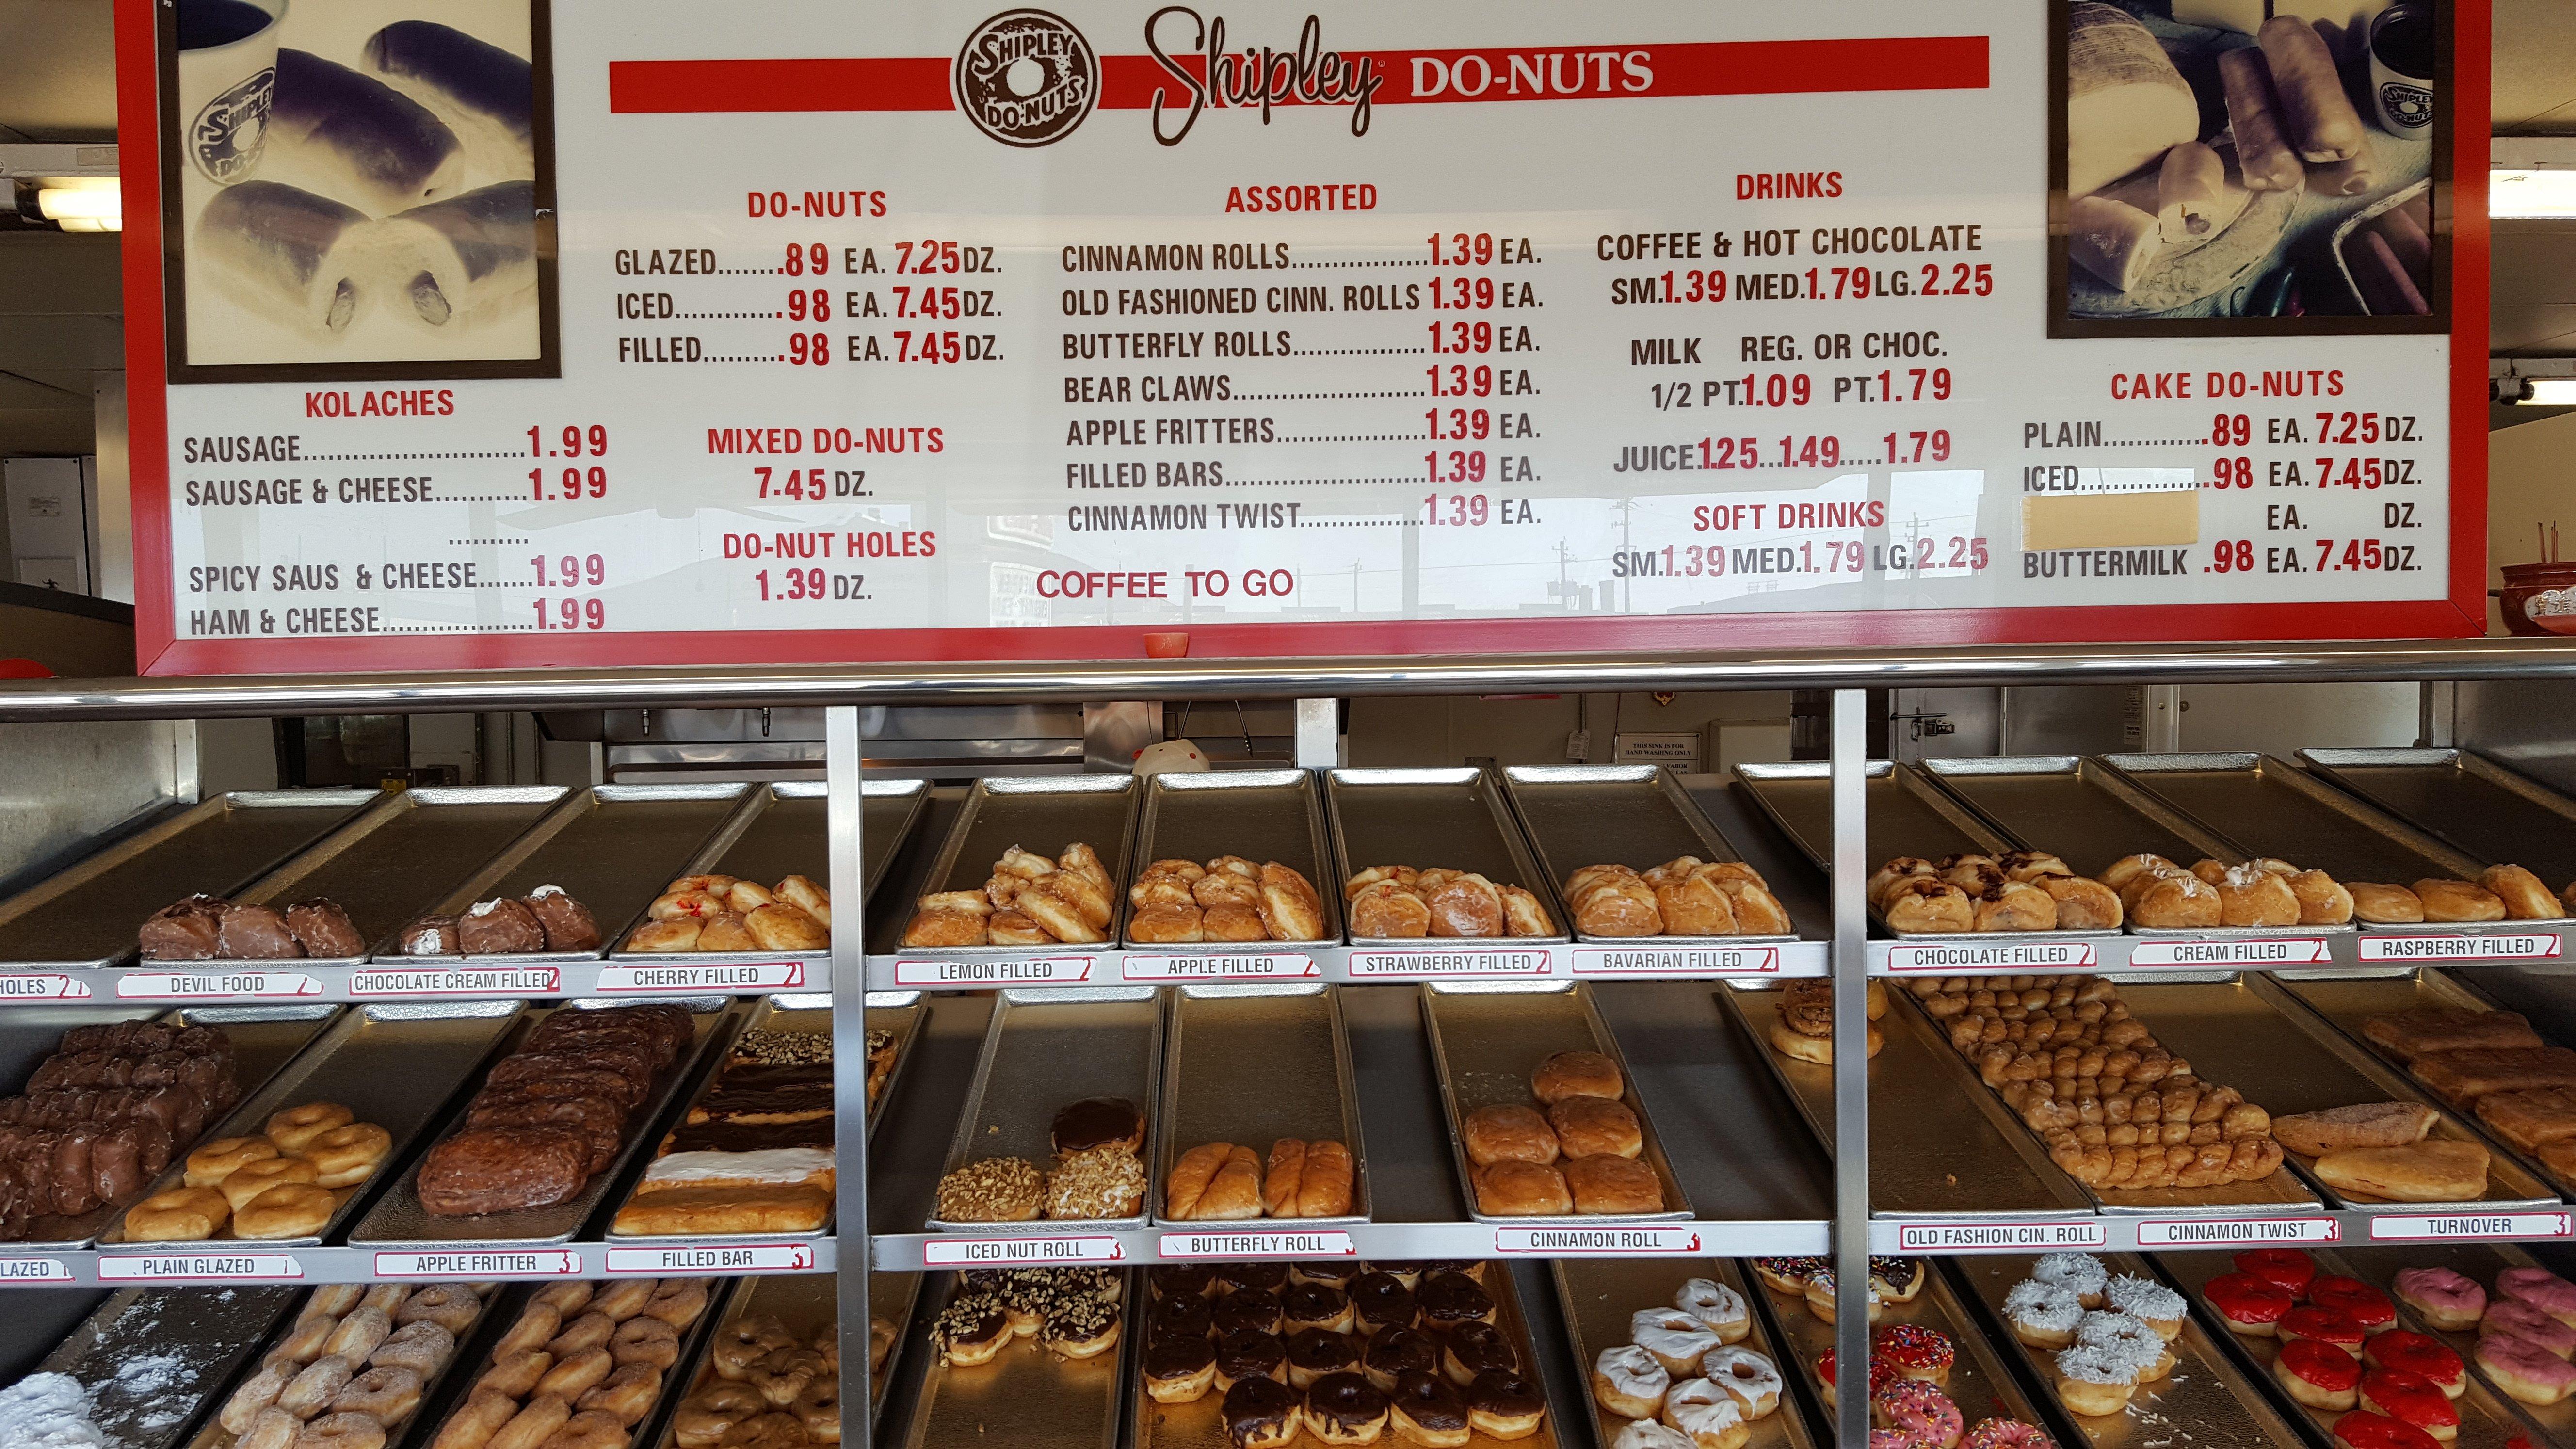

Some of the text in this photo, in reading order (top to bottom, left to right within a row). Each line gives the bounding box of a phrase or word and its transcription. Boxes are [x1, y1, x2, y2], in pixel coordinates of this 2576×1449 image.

[972, 33, 1073, 75] SHIPLEY
[1145, 6, 1655, 146] Shipley DO-NUTS
[987, 78, 1079, 128] DO-NUTS
[1225, 184, 1376, 212] ASSORTED
[1737, 172, 1842, 200] DRINKS
[748, 191, 886, 217] DO-NUTS
[616, 249, 715, 275] GLAZED
[895, 240, 959, 274] 7.25
[1063, 233, 1492, 272] CINNAMON ROLLS 1.39
[1598, 225, 1981, 260] COFFEE HOT CHOCOLATE
[1063, 277, 1494, 315] OLD FASHIONED CINN. ROLLS 1.39
[1659, 270, 1726, 303] 1.39
[1803, 267, 1870, 299] 1.79
[1921, 263, 1992, 296] 2.25
[618, 293, 673, 319] ICED
[893, 287, 960, 319] 7.45
[619, 337, 701, 362] FILLED
[894, 331, 960, 364] 7.45
[1063, 321, 1491, 359] BUTTERFLY ROLLS 1.39
[1632, 331, 1947, 365] MILK REG. OR CHOC.
[1065, 365, 1491, 402] BEAR CLAWS 1.39
[1652, 382, 1691, 411] 1/2
[1740, 374, 1810, 407] 1.09
[1878, 368, 1950, 401] 1.79
[2112, 370, 2343, 399] CAKE DO-NUTS
[306, 390, 453, 417] KOLACHES
[708, 428, 943, 453] MIXED DO-NUTS
[1067, 408, 1489, 445] APPLE FRITTERS 1.39
[2025, 421, 2101, 448] PLAIN
[2316, 412, 2379, 444] 7.25
[185, 425, 607, 463] SAUSAGE 1.99
[1884, 430, 1950, 463] 1.79
[755, 467, 826, 500] 7.45
[1067, 451, 1485, 488] FILLED BARS 1.39
[2024, 466, 2078, 491] ICED
[2316, 458, 2381, 489] 7.45
[187, 467, 606, 506] SAUSAGE CHEESE 1.99
[1069, 493, 1488, 531] CINNAMON TWIST 1.39
[1694, 501, 1884, 531] SOFT DRINKS
[724, 531, 935, 558] DO-NUT HOLES
[1660, 545, 1725, 577] 1.39
[1797, 541, 1865, 573] 1.79
[1917, 536, 1988, 570] 2.25
[2024, 550, 2187, 578] BUTTERMILK
[2316, 539, 2381, 572] 7.45
[190, 554, 604, 592] SPICY SAUS CHEESE 1.99
[756, 568, 825, 600] 1.39
[1037, 569, 1293, 598] COFFEE TO GO
[192, 598, 604, 635] HAM CHEESE 1.99
[1603, 952, 1741, 968] BAVARIAN FILLED
[1915, 947, 2068, 965] CHOCOLATE FILLED
[2174, 944, 2287, 961] CREAM FILLED
[2383, 938, 2534, 956] RASPBERRY FILLED
[634, 968, 758, 986] CHERRY FILLED
[940, 963, 1052, 979] LEMON FILLED
[1168, 958, 1273, 974] APPLE FILLED
[1366, 954, 1531, 972] STRAWBERRY FILLED
[171, 976, 265, 992] DEVIL FOOD
[355, 971, 549, 991] CHOCOLATE CREAM FILLED
[1530, 1232, 1661, 1247] CINNAMON ROLL
[1907, 1226, 2096, 1245] OLD FASHION CIN. ROLL
[2169, 1223, 2306, 1240] CINNAMON TWIST
[2428, 1219, 2511, 1233] TURNOVER
[662, 1250, 753, 1267] FILLED BAR
[966, 1242, 1083, 1259] ICED NUT ROLL
[1191, 1236, 1325, 1253] BUTTERFLY ROLL
[143, 1259, 255, 1275] PLAIN GLAZED
[416, 1255, 536, 1272] APPLE FRITTER
